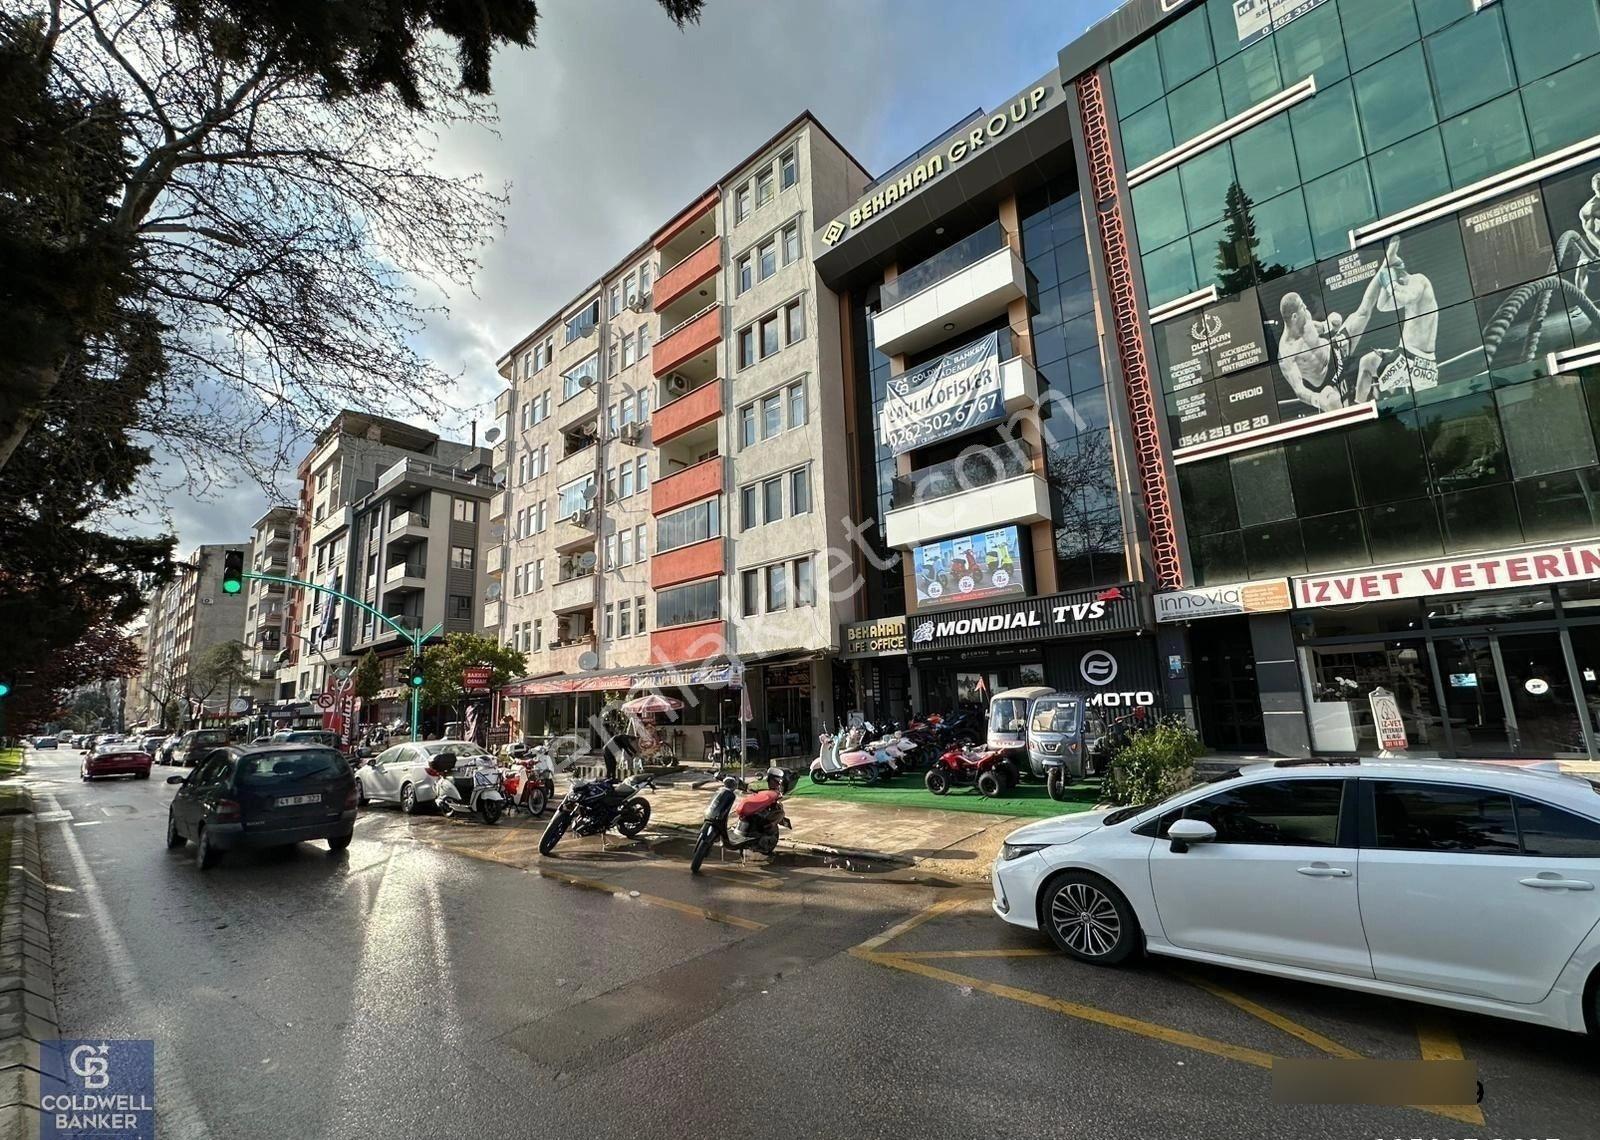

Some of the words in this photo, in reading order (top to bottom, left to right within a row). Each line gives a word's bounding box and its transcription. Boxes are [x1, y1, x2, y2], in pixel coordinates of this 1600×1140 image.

[1273, 13, 1292, 29] 262
[947, 86, 1045, 162] GROUP
[1338, 252, 1359, 266] KEEP
[1339, 260, 1361, 273] CALM
[1229, 386, 1263, 403] CARDIO
[889, 423, 922, 448] 0262
[924, 412, 952, 434] 502
[955, 402, 975, 423] 67
[978, 393, 998, 414] 67
[1179, 431, 1207, 447] 0544
[1233, 419, 1251, 433] 02
[1252, 415, 1269, 428] 20
[1301, 573, 1403, 604] İZVET
[1421, 546, 1600, 590] VETERİN
[1159, 589, 1239, 611] innovia
[936, 610, 1041, 637] MONDIAL
[1053, 601, 1105, 624] TVS
[849, 641, 866, 652] LIFE
[870, 637, 905, 651] OFFICE
